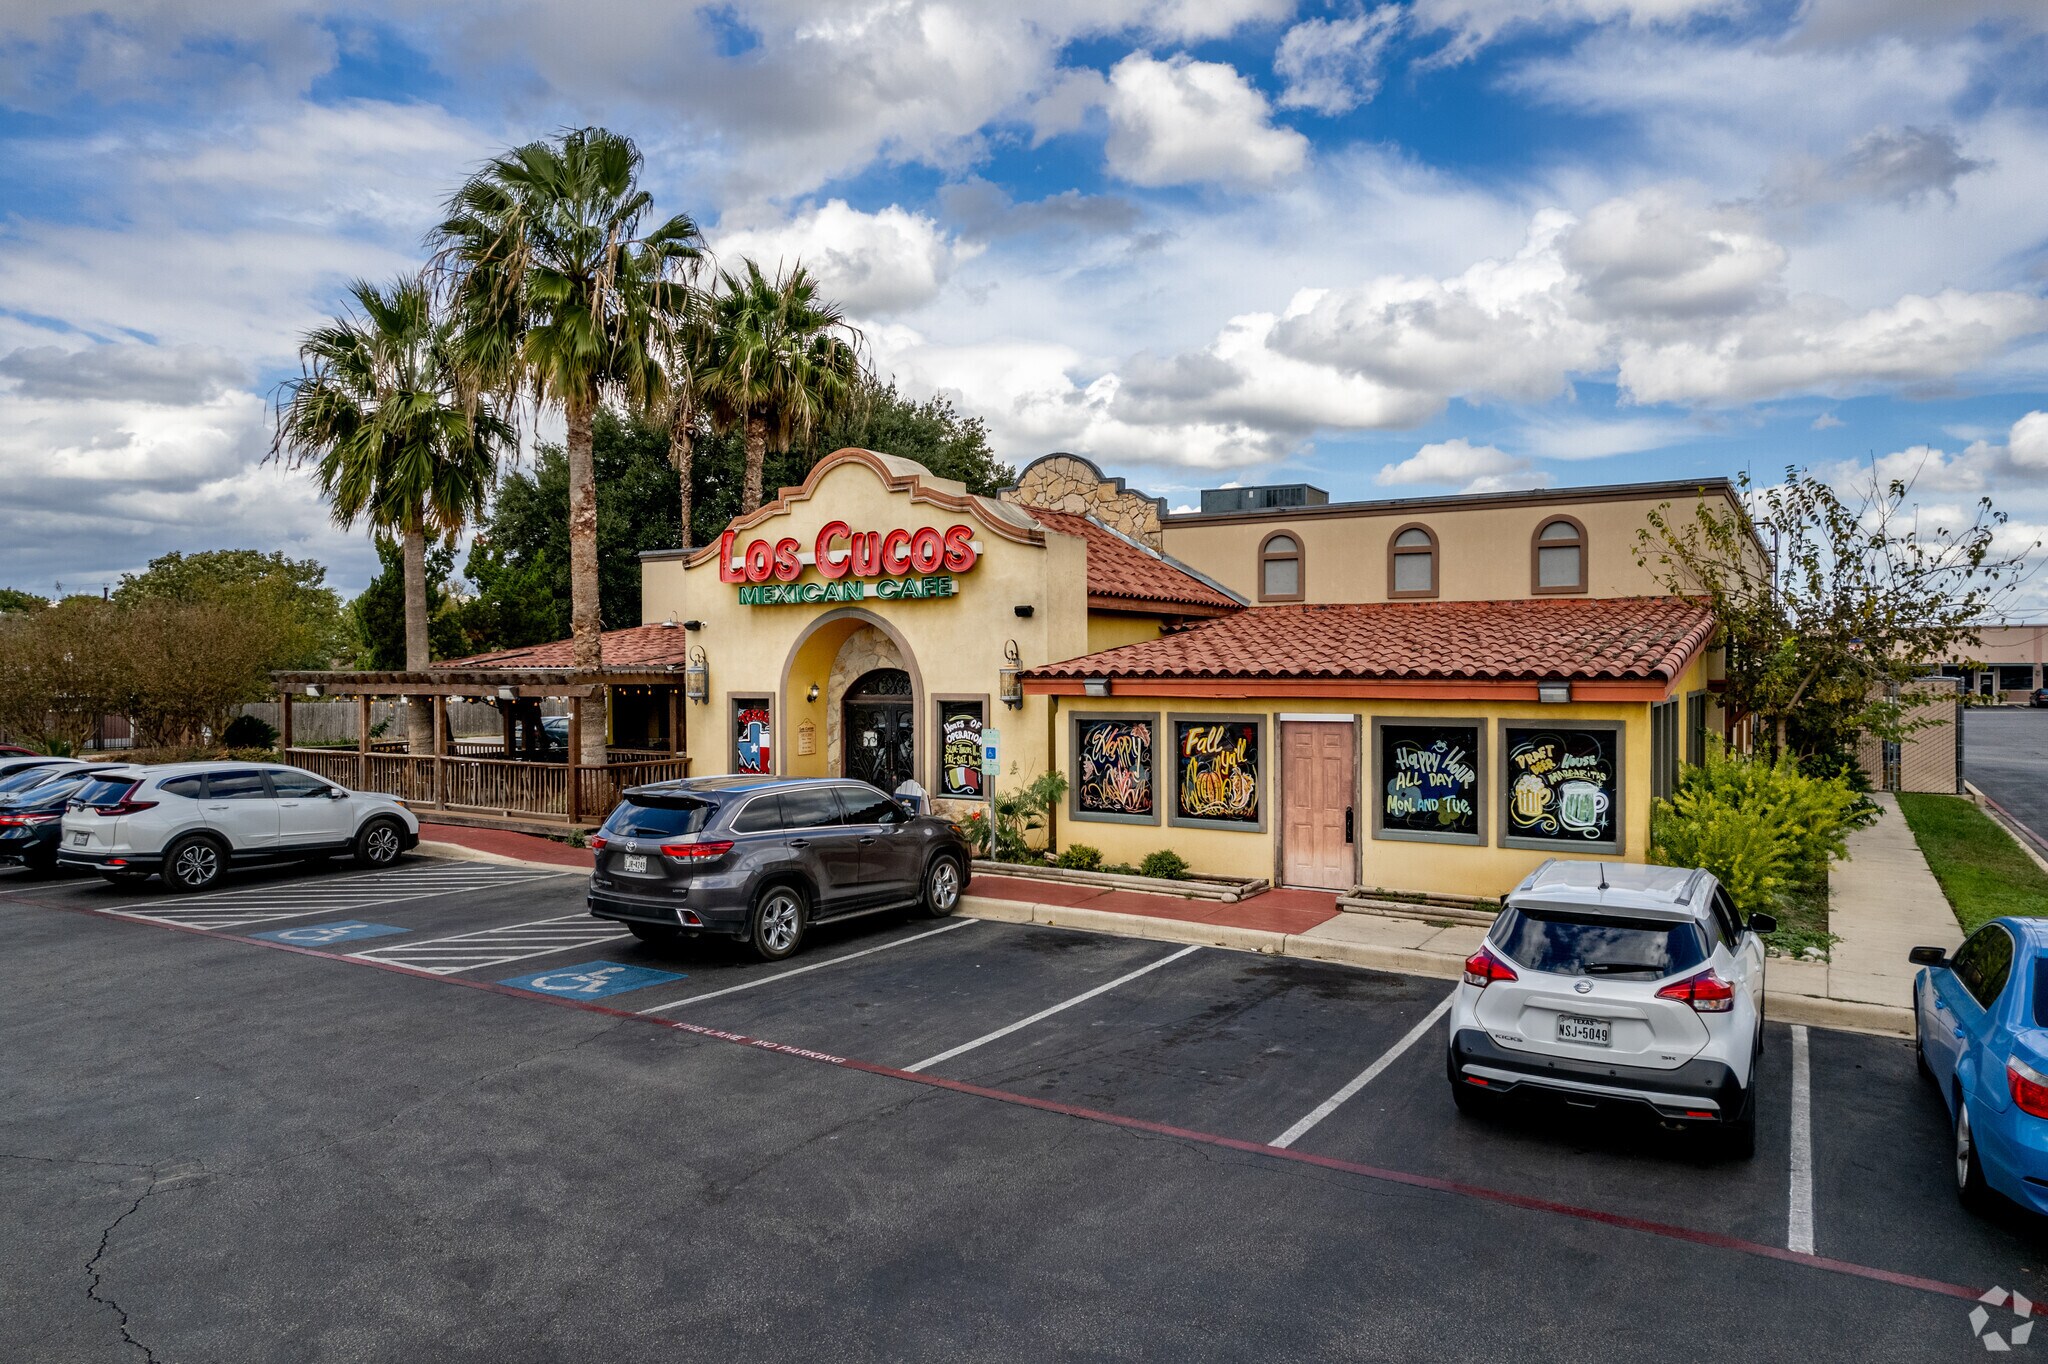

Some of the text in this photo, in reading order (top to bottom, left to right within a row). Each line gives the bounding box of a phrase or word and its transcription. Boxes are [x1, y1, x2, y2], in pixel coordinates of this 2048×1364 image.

[720, 530, 803, 583] Los
[738, 576, 953, 605] MEXICAN CAFE
[1185, 725, 1224, 756] Fall
[1515, 744, 1555, 769] DRAFT
[1396, 771, 1454, 791] ALL DAY
[1417, 798, 1439, 811] AND
[1573, 1018, 1595, 1026] TEXAS
[672, 1022, 847, 1064] FIRE LANE NO PARKING
